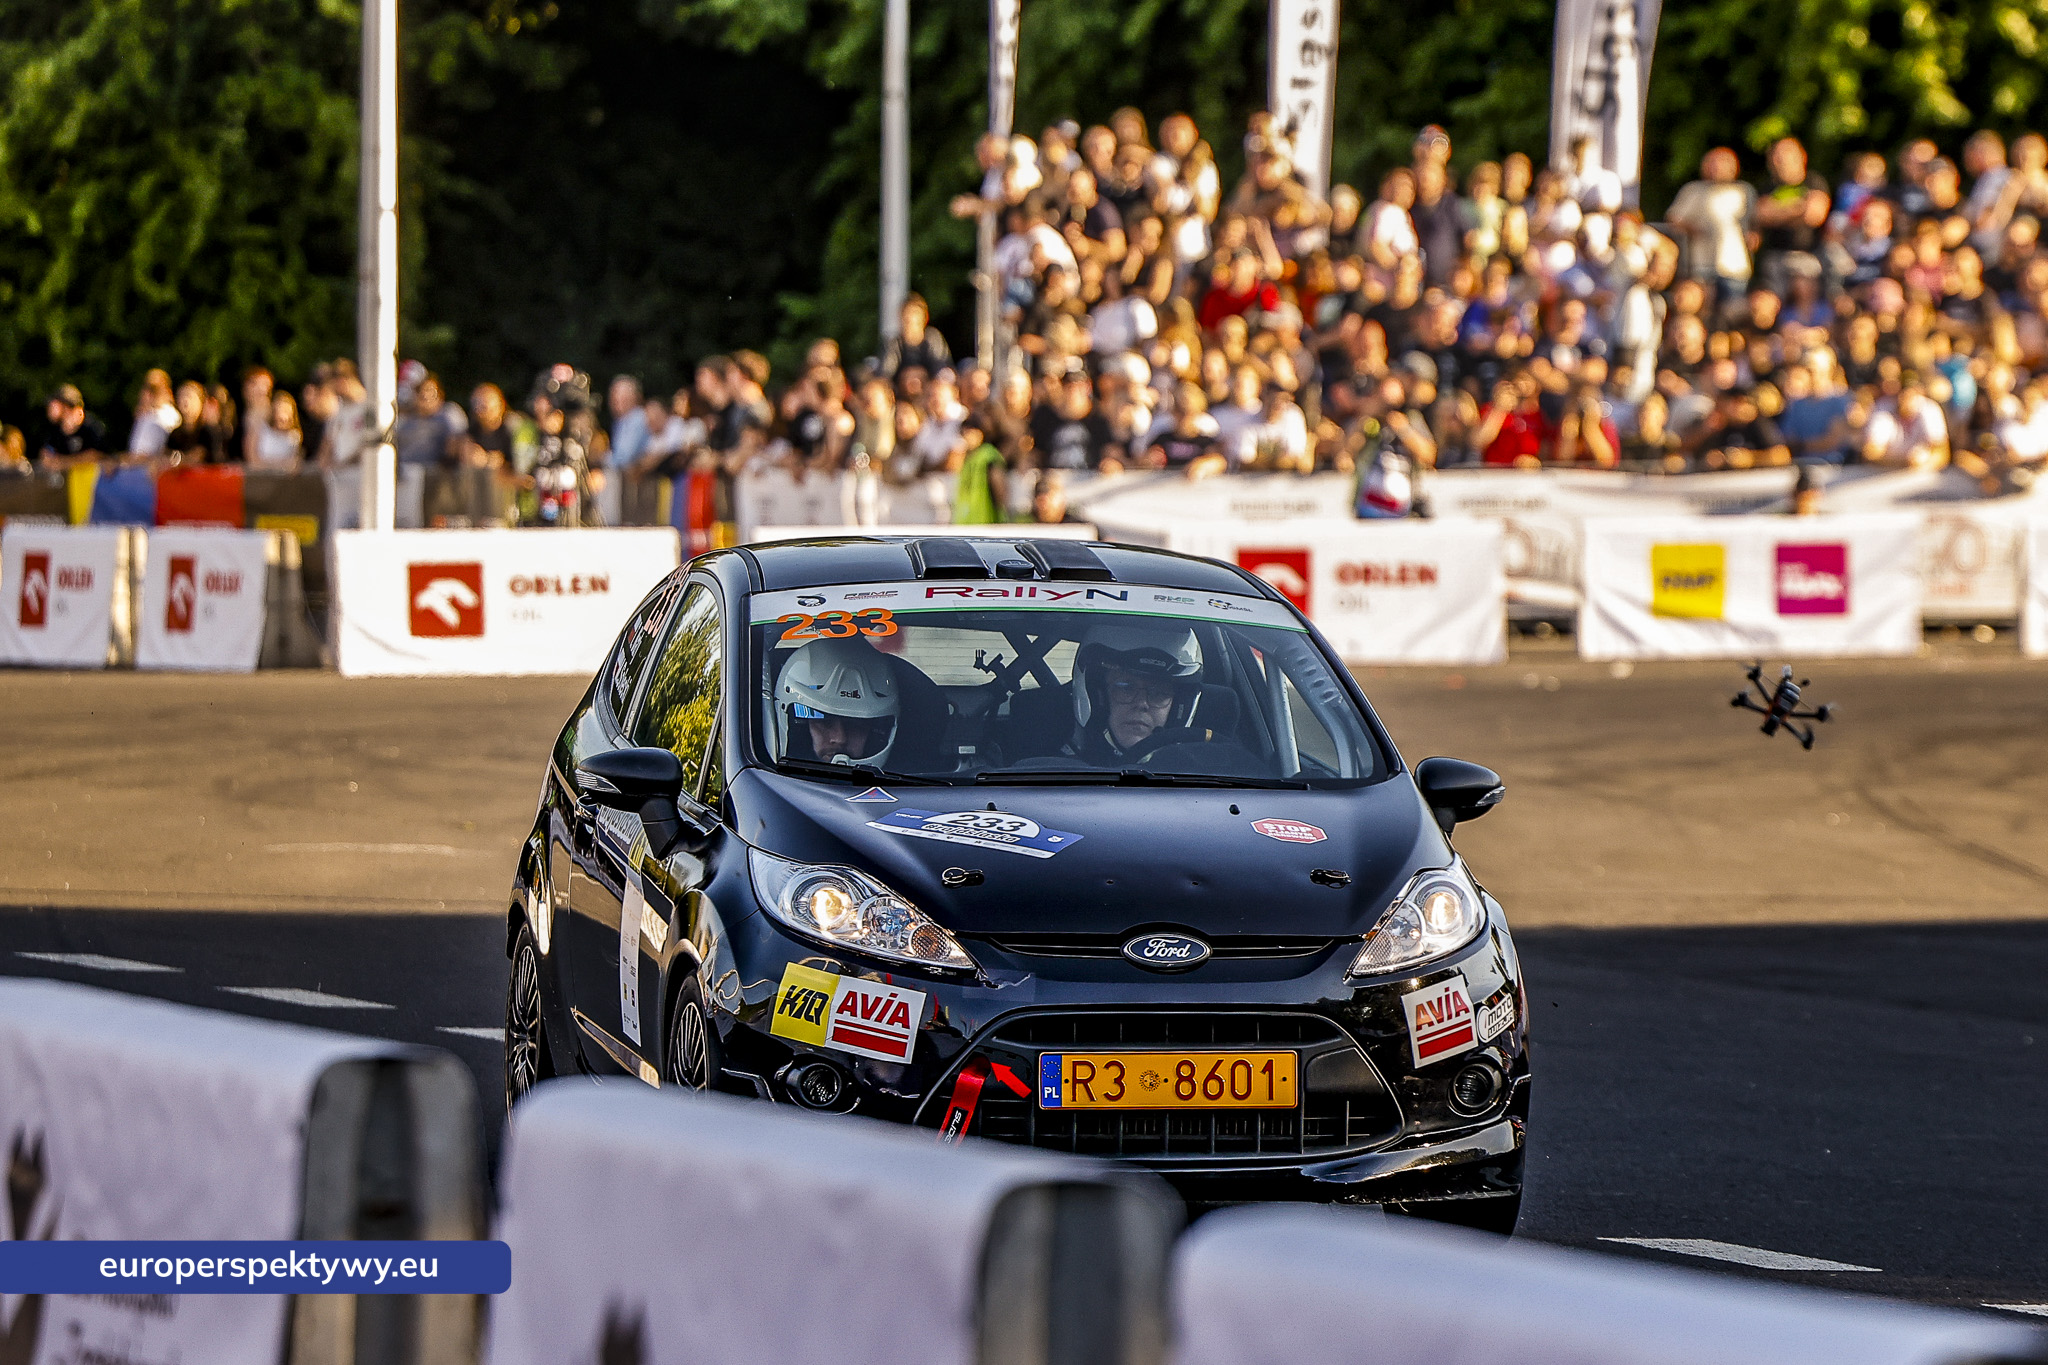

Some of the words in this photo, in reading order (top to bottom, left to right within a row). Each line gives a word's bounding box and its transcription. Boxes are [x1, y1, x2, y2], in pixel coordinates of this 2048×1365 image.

[507, 572, 610, 597] ORLEN
[1334, 562, 1438, 586] ORLEN
[924, 586, 1128, 602] RallyN
[776, 607, 898, 640] 233
[947, 814, 1027, 832] 233
[1262, 822, 1313, 833] STOP
[1143, 937, 1191, 959] Ford
[1071, 1059, 1128, 1102] R3
[1174, 1058, 1275, 1101] 8601
[1044, 1087, 1060, 1099] PL
